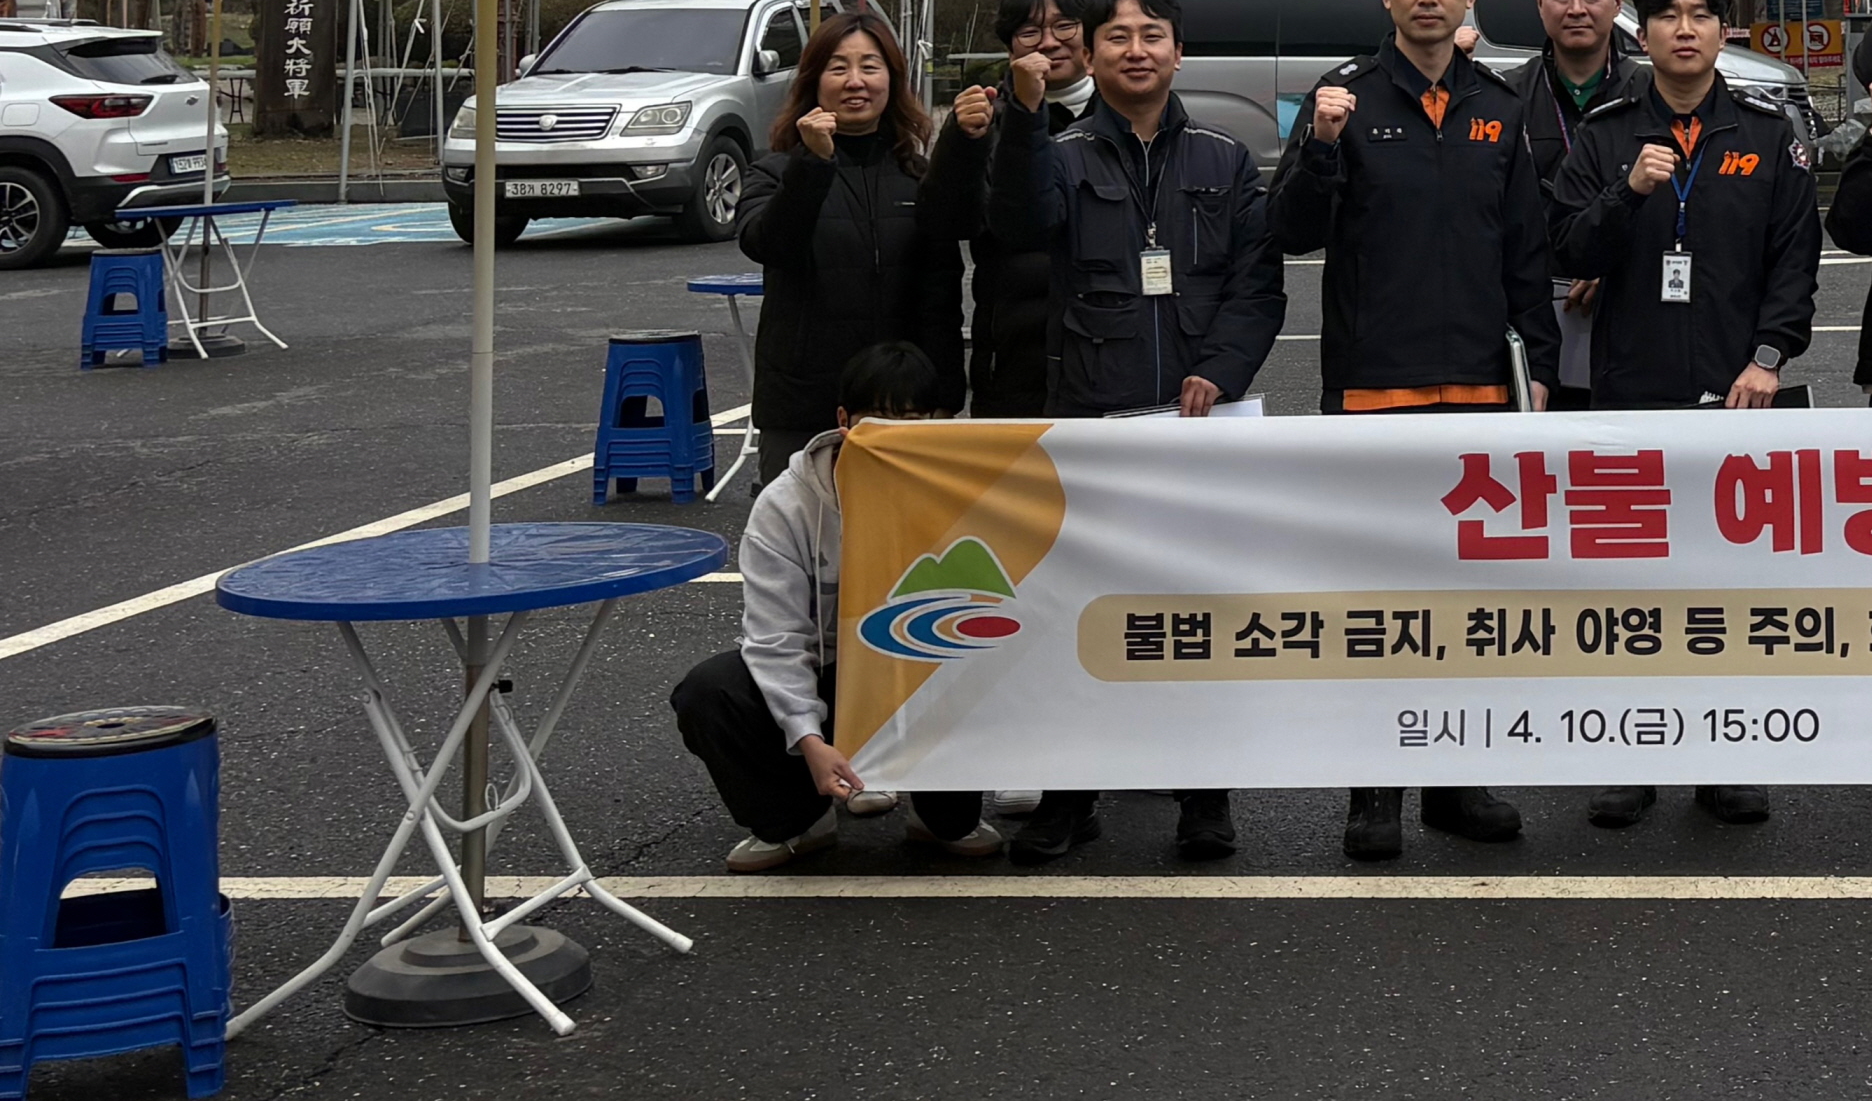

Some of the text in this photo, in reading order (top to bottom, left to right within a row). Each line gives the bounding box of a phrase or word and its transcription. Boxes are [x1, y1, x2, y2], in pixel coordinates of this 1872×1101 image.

[1469, 118, 1502, 142] 119
[1719, 151, 1760, 175] 119
[540, 183, 572, 195] 8297
[1441, 449, 1671, 561] 산불
[1123, 612, 1212, 661] 불법
[1234, 611, 1325, 659] 소각
[1344, 609, 1446, 661] 금지,
[1465, 607, 1556, 657] 취사
[1576, 607, 1662, 656] 야영
[1684, 607, 1727, 656] 등
[1748, 606, 1850, 658] 주의,
[1397, 709, 1466, 747] 일시
[1507, 709, 1542, 744] 4.
[1560, 708, 1685, 747] 10.(금)
[1703, 708, 1820, 743] 15:00
